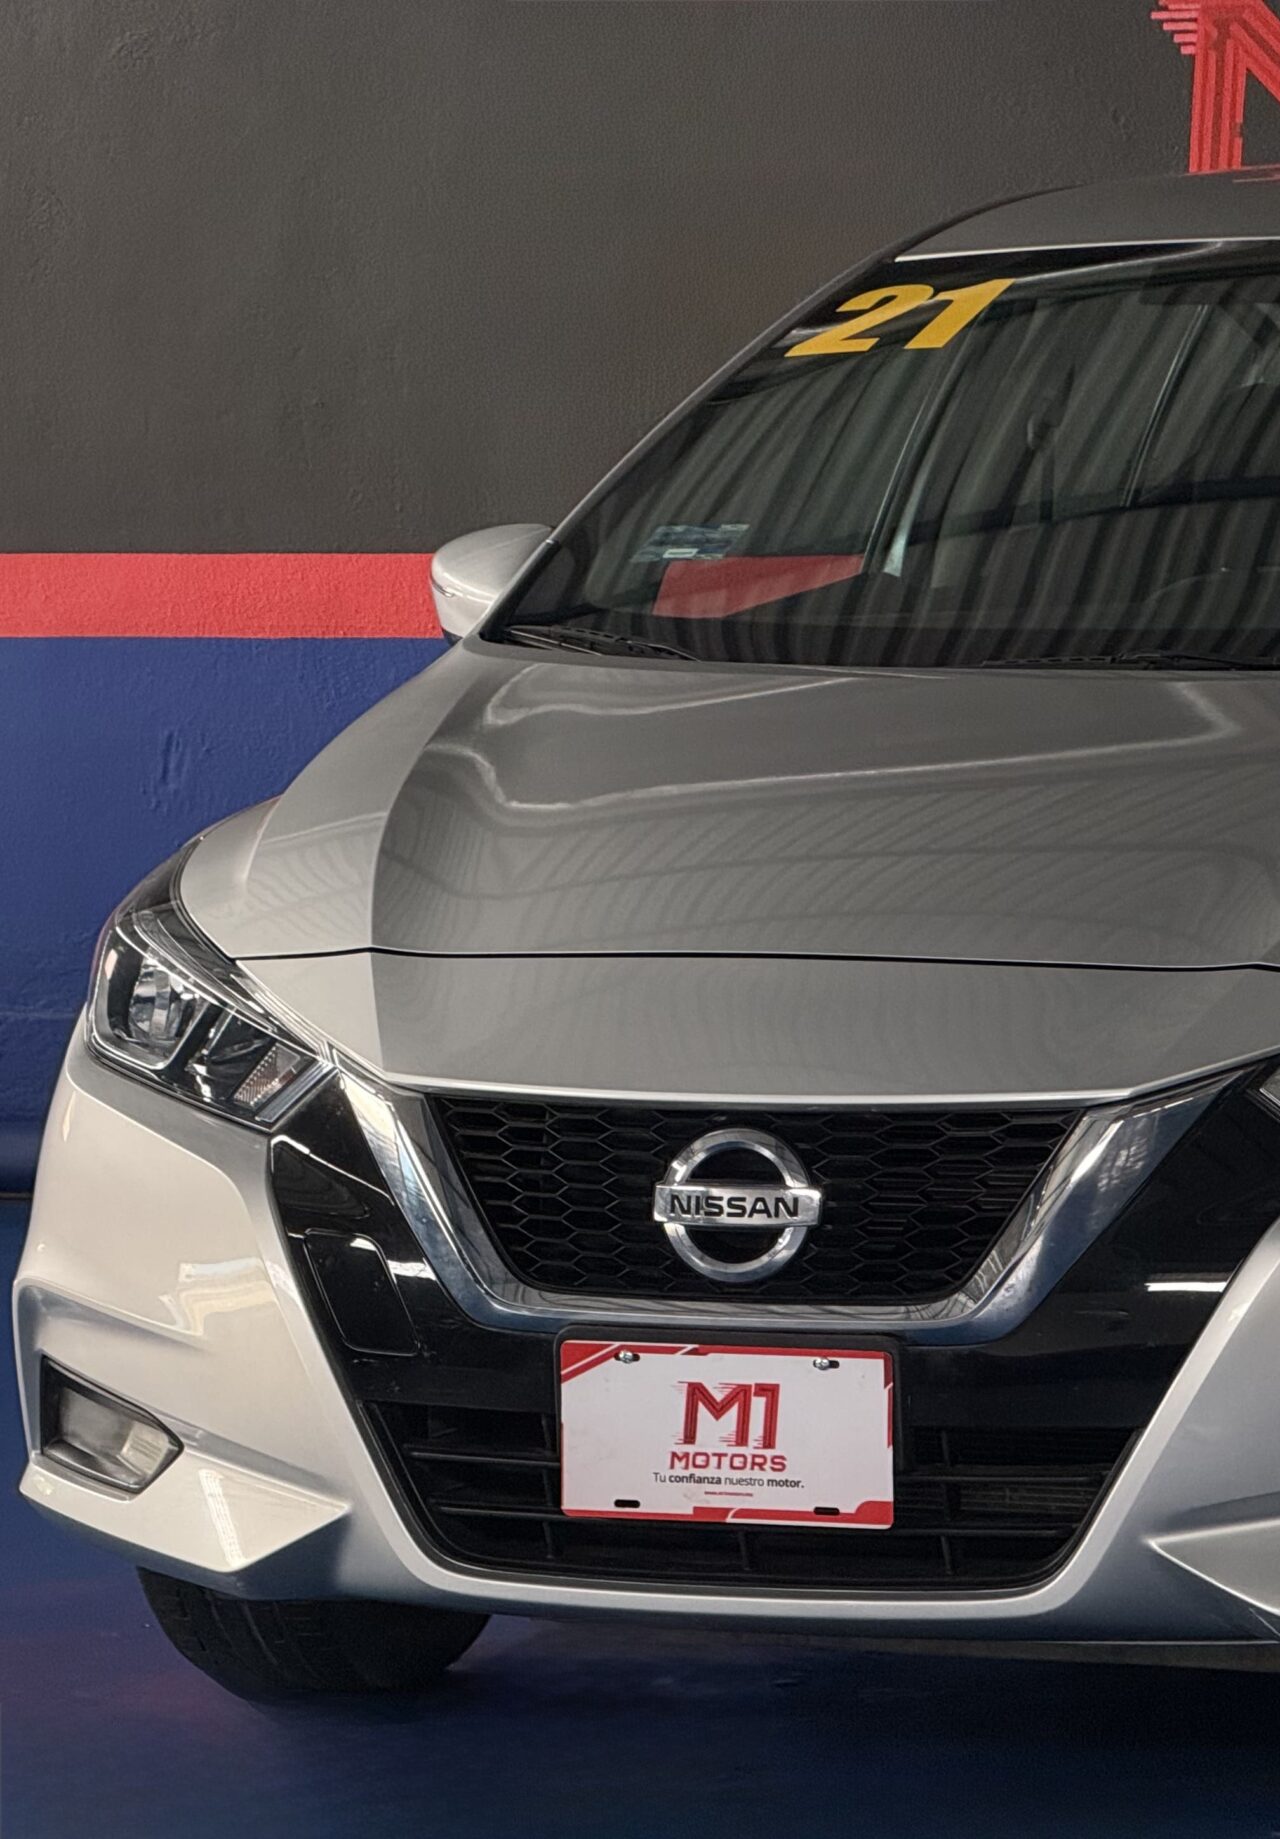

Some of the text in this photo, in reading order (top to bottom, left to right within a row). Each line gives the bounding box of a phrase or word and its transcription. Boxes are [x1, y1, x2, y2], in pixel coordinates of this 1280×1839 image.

[784, 277, 1015, 357] 21
[669, 1194, 800, 1219] NISSAN
[672, 1380, 781, 1450] M1
[668, 1451, 787, 1473] MOTORS
[653, 1472, 805, 1489] Tu confianza nuestro motor.
